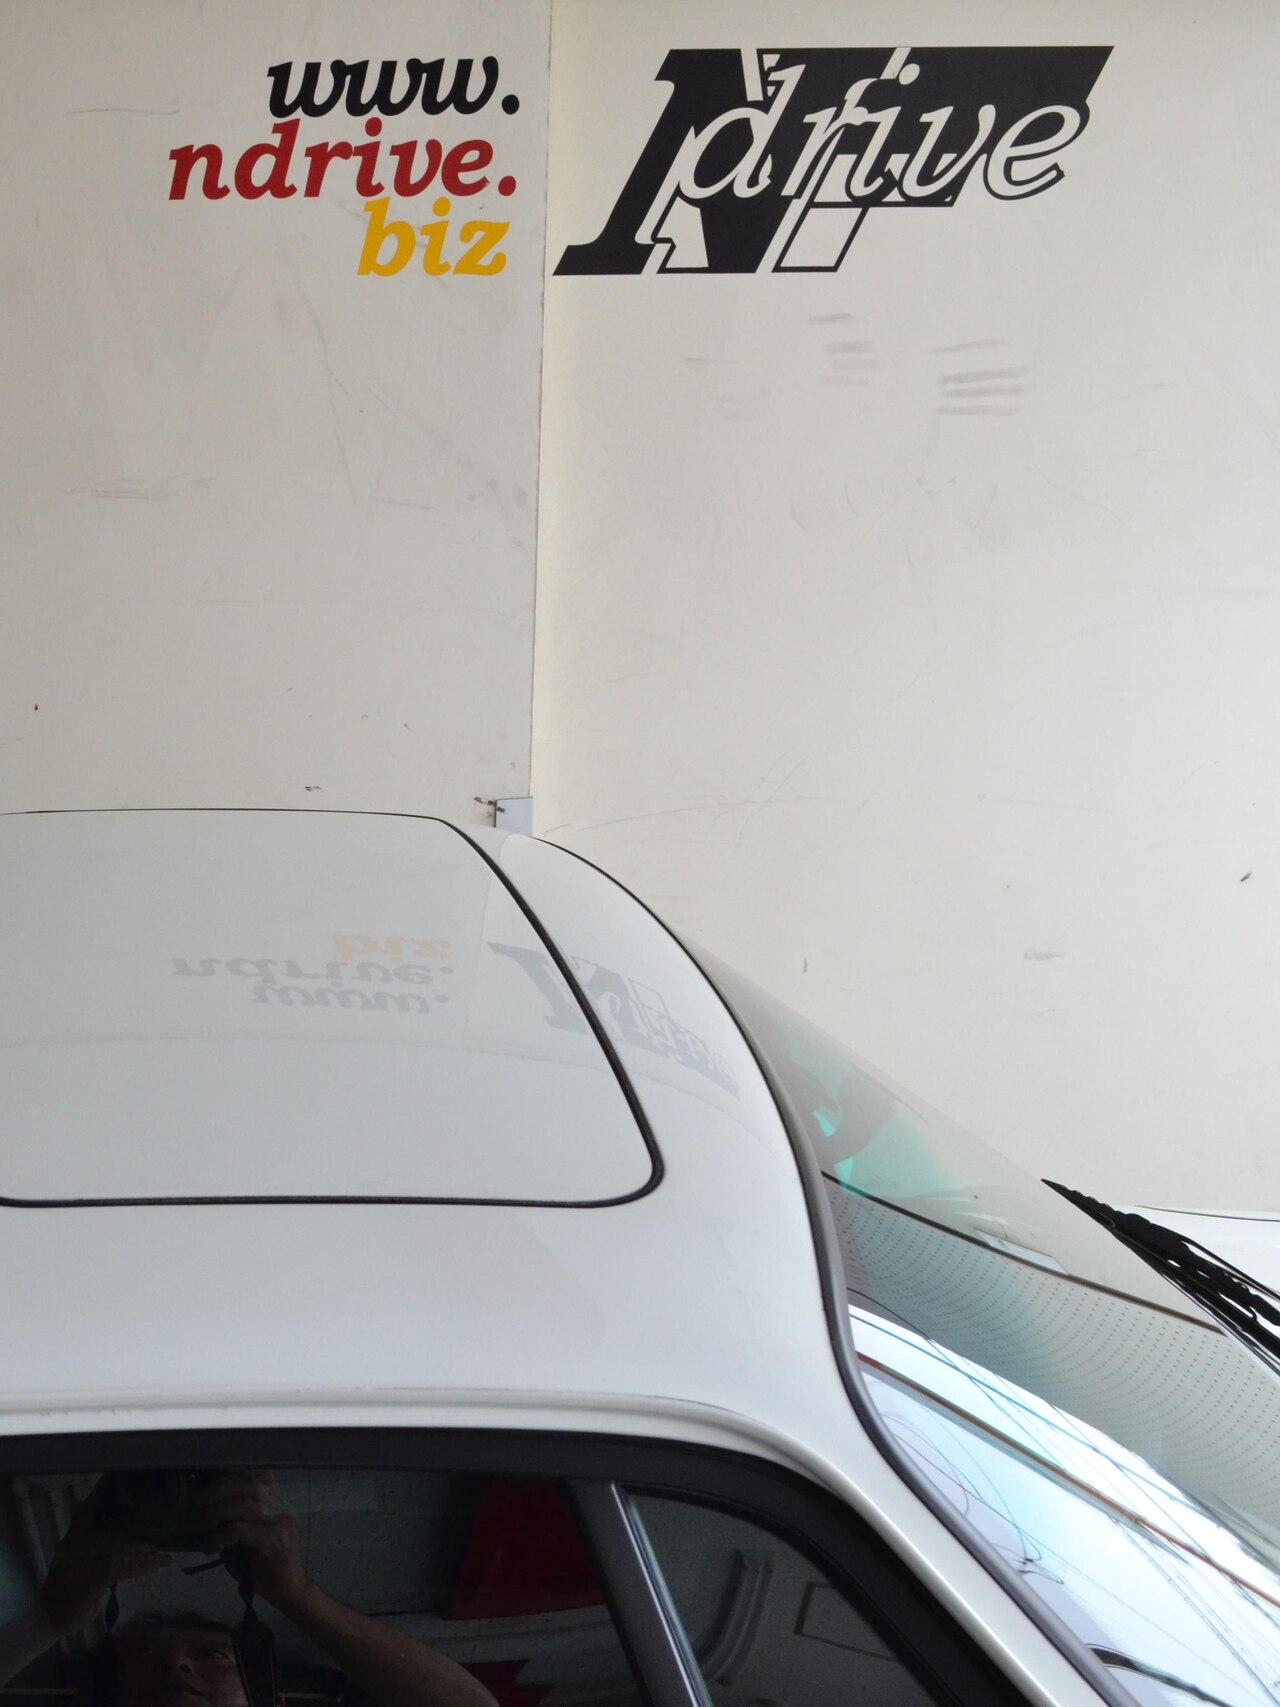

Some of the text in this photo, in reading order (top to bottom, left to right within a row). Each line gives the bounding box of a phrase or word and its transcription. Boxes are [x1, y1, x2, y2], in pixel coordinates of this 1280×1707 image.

[267, 56, 520, 118] www.
[169, 117, 517, 201] ndrive.
[357, 196, 511, 278] biz
